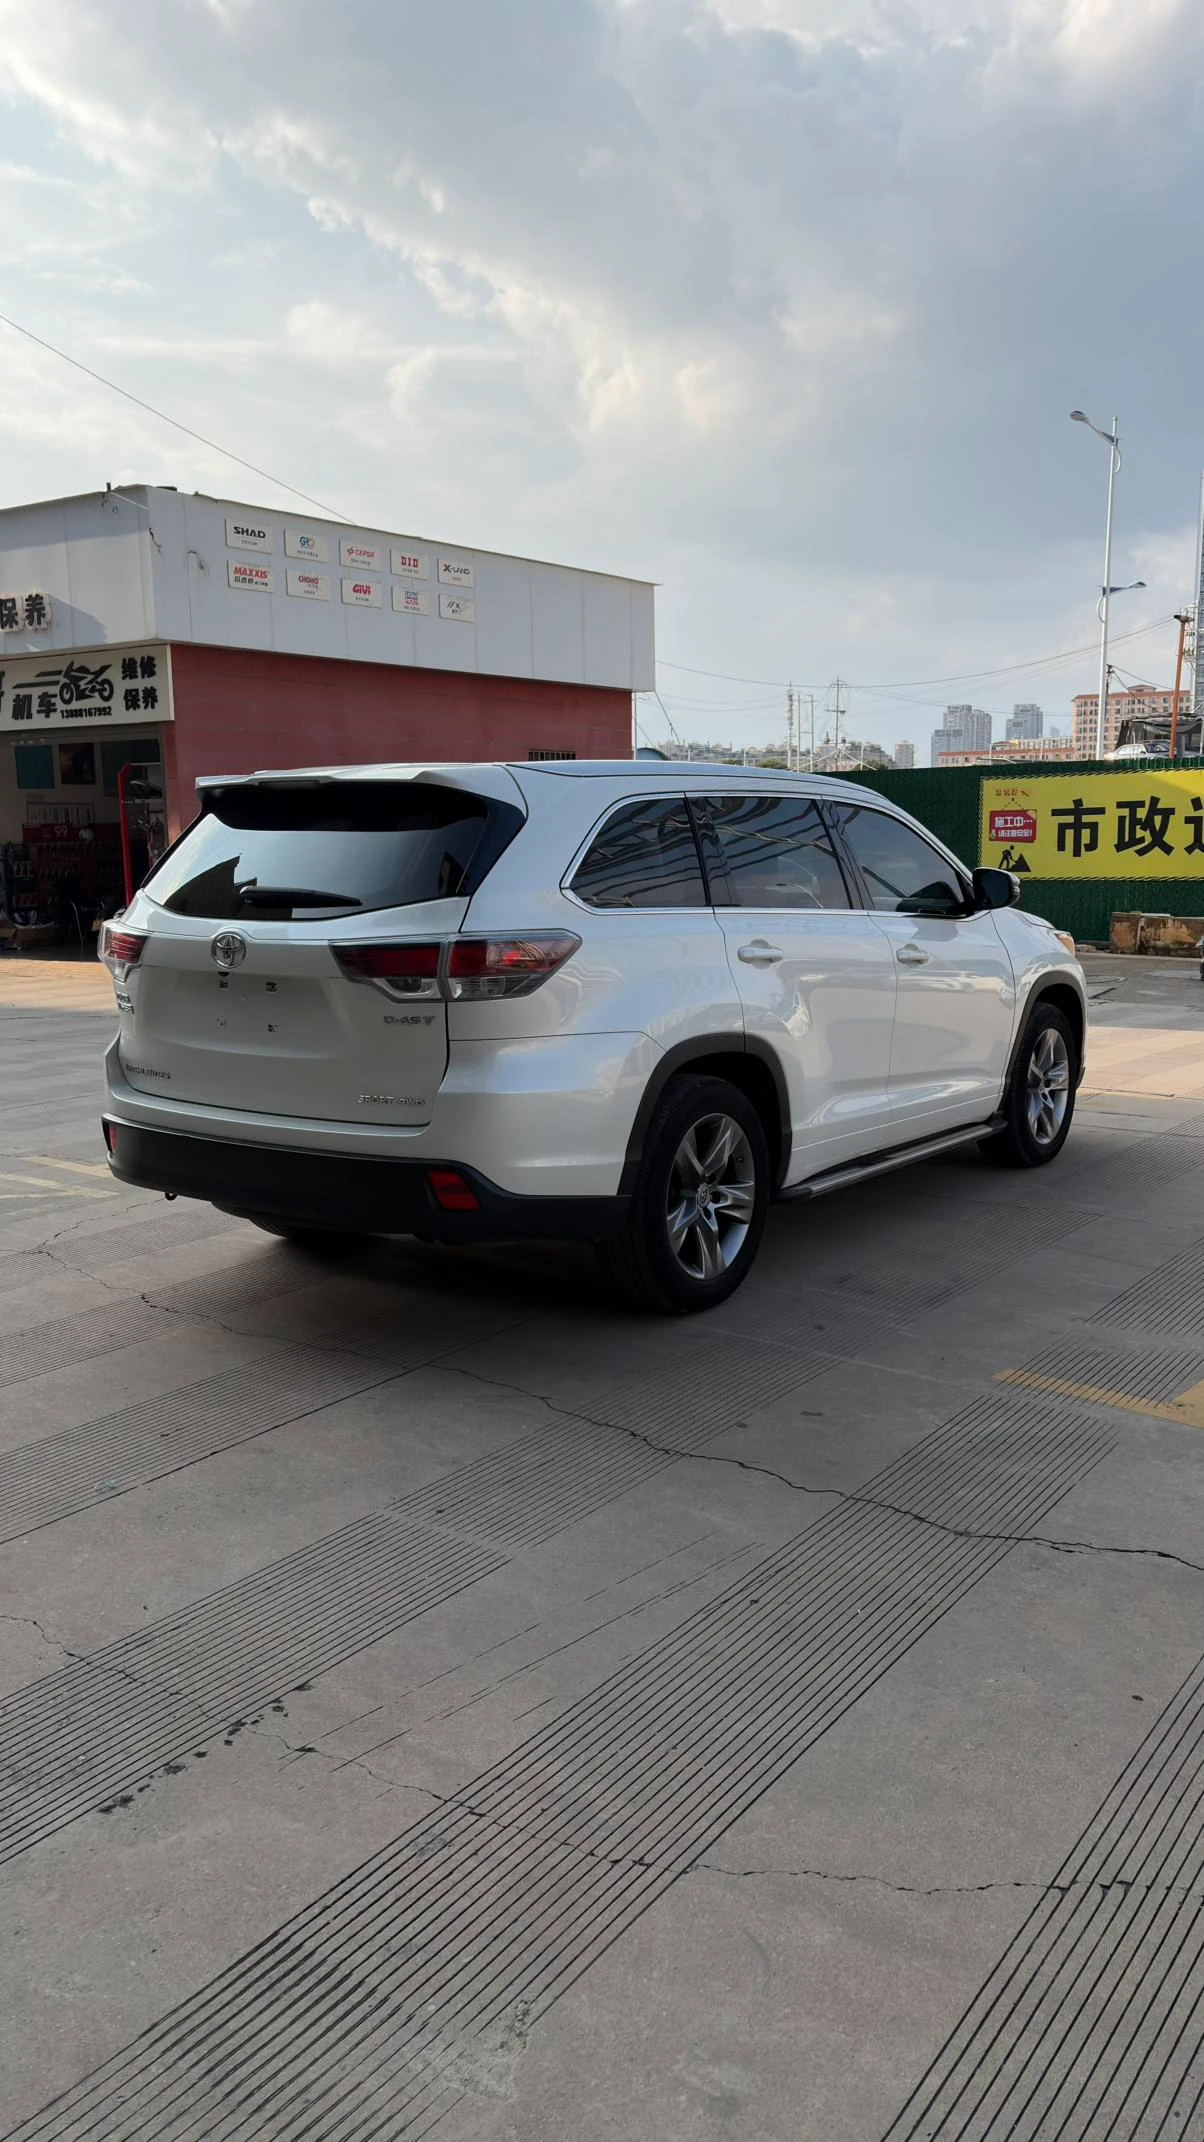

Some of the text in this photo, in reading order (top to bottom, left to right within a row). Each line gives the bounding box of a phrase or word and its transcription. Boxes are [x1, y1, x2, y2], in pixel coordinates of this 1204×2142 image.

[234, 526, 266, 539] SHAD
[401, 555, 419, 568] DID
[233, 566, 268, 579] MAXXIS
[352, 584, 371, 595] GIVI
[0, 594, 46, 629] 保养
[121, 656, 157, 680] 维修
[12, 692, 57, 720] 机车
[123, 686, 158, 711] 保养
